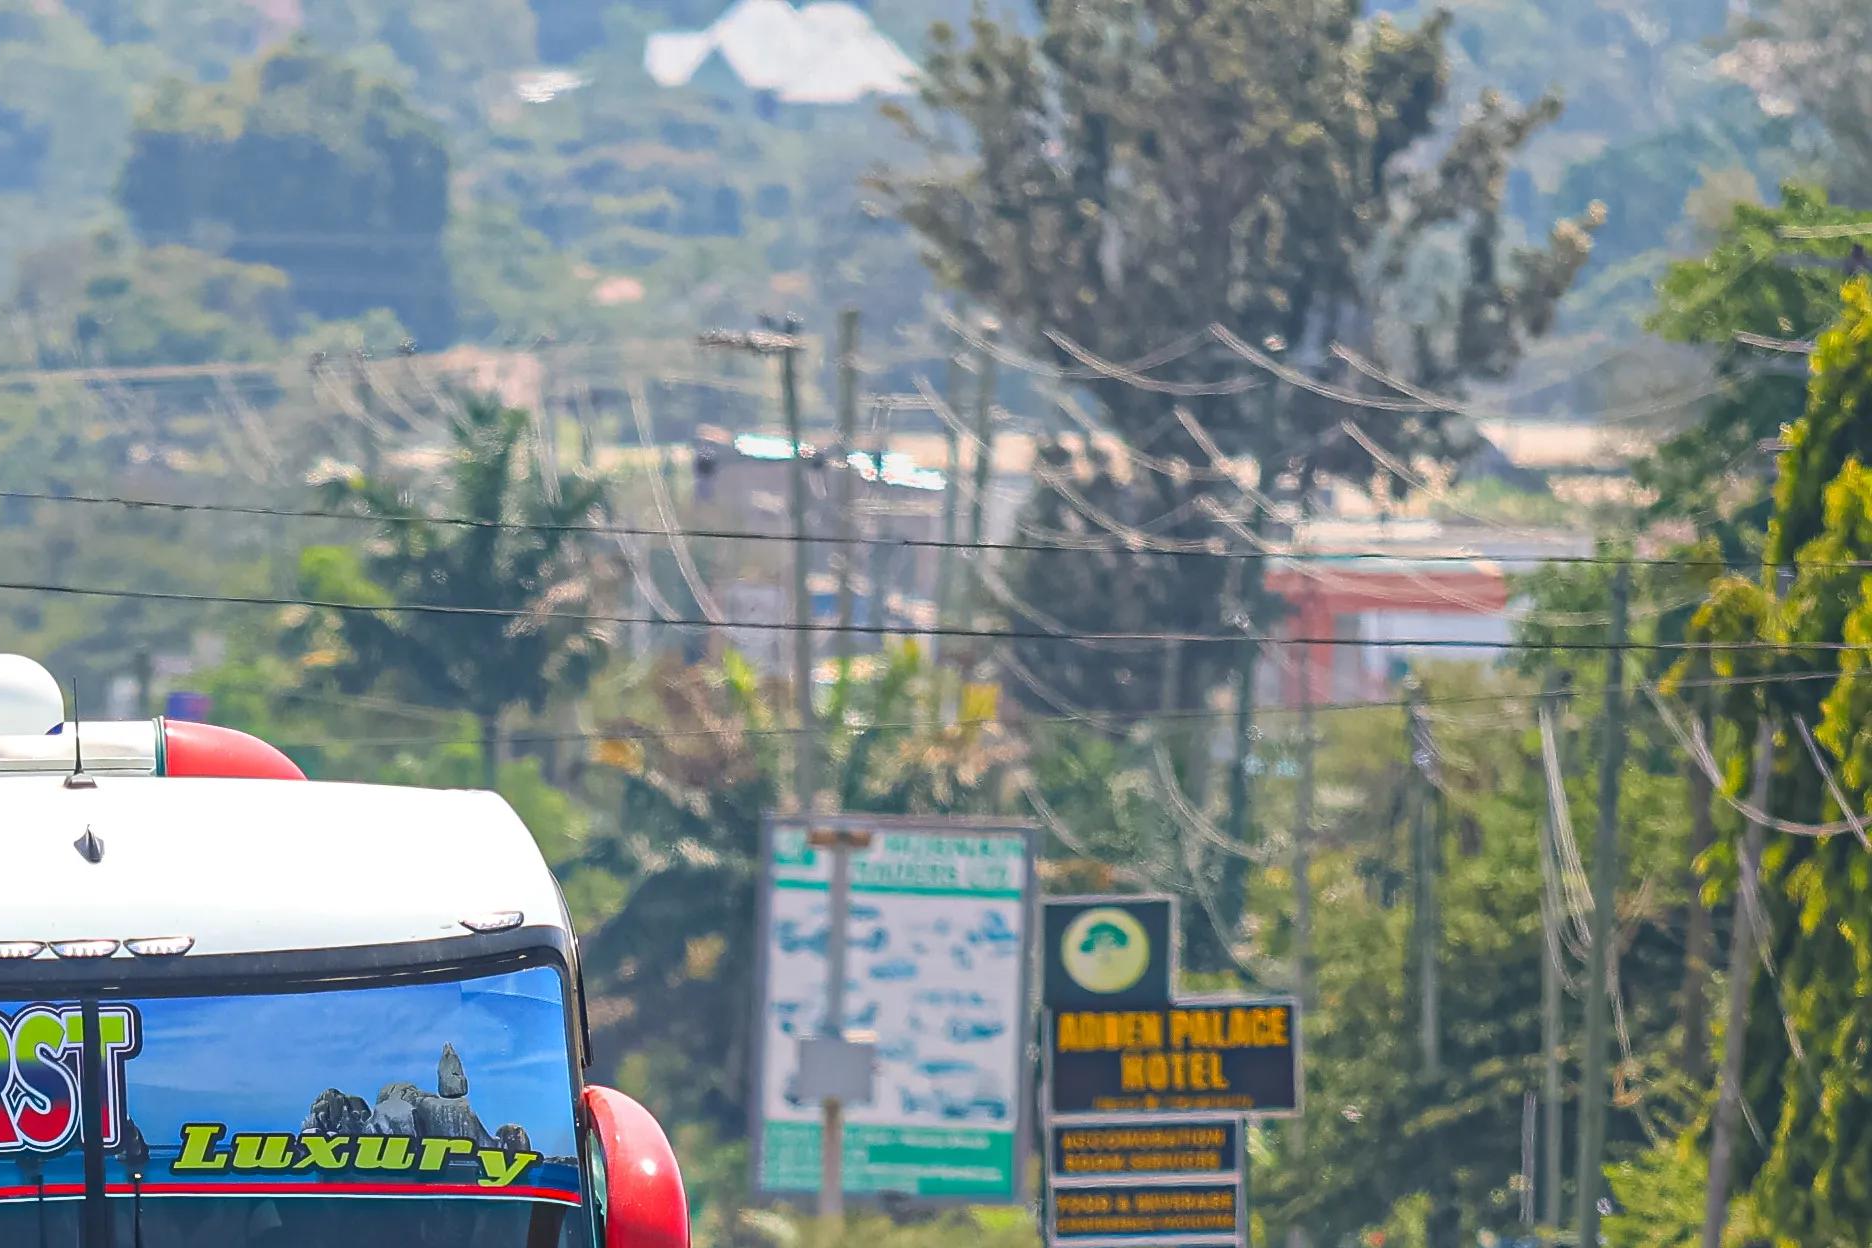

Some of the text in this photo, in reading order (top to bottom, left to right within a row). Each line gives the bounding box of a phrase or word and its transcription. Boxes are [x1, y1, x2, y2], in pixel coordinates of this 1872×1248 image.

[1169, 1007, 1289, 1049] PALACE
[1121, 1052, 1229, 1092] HOTEL
[172, 1124, 539, 1188] Luxury
